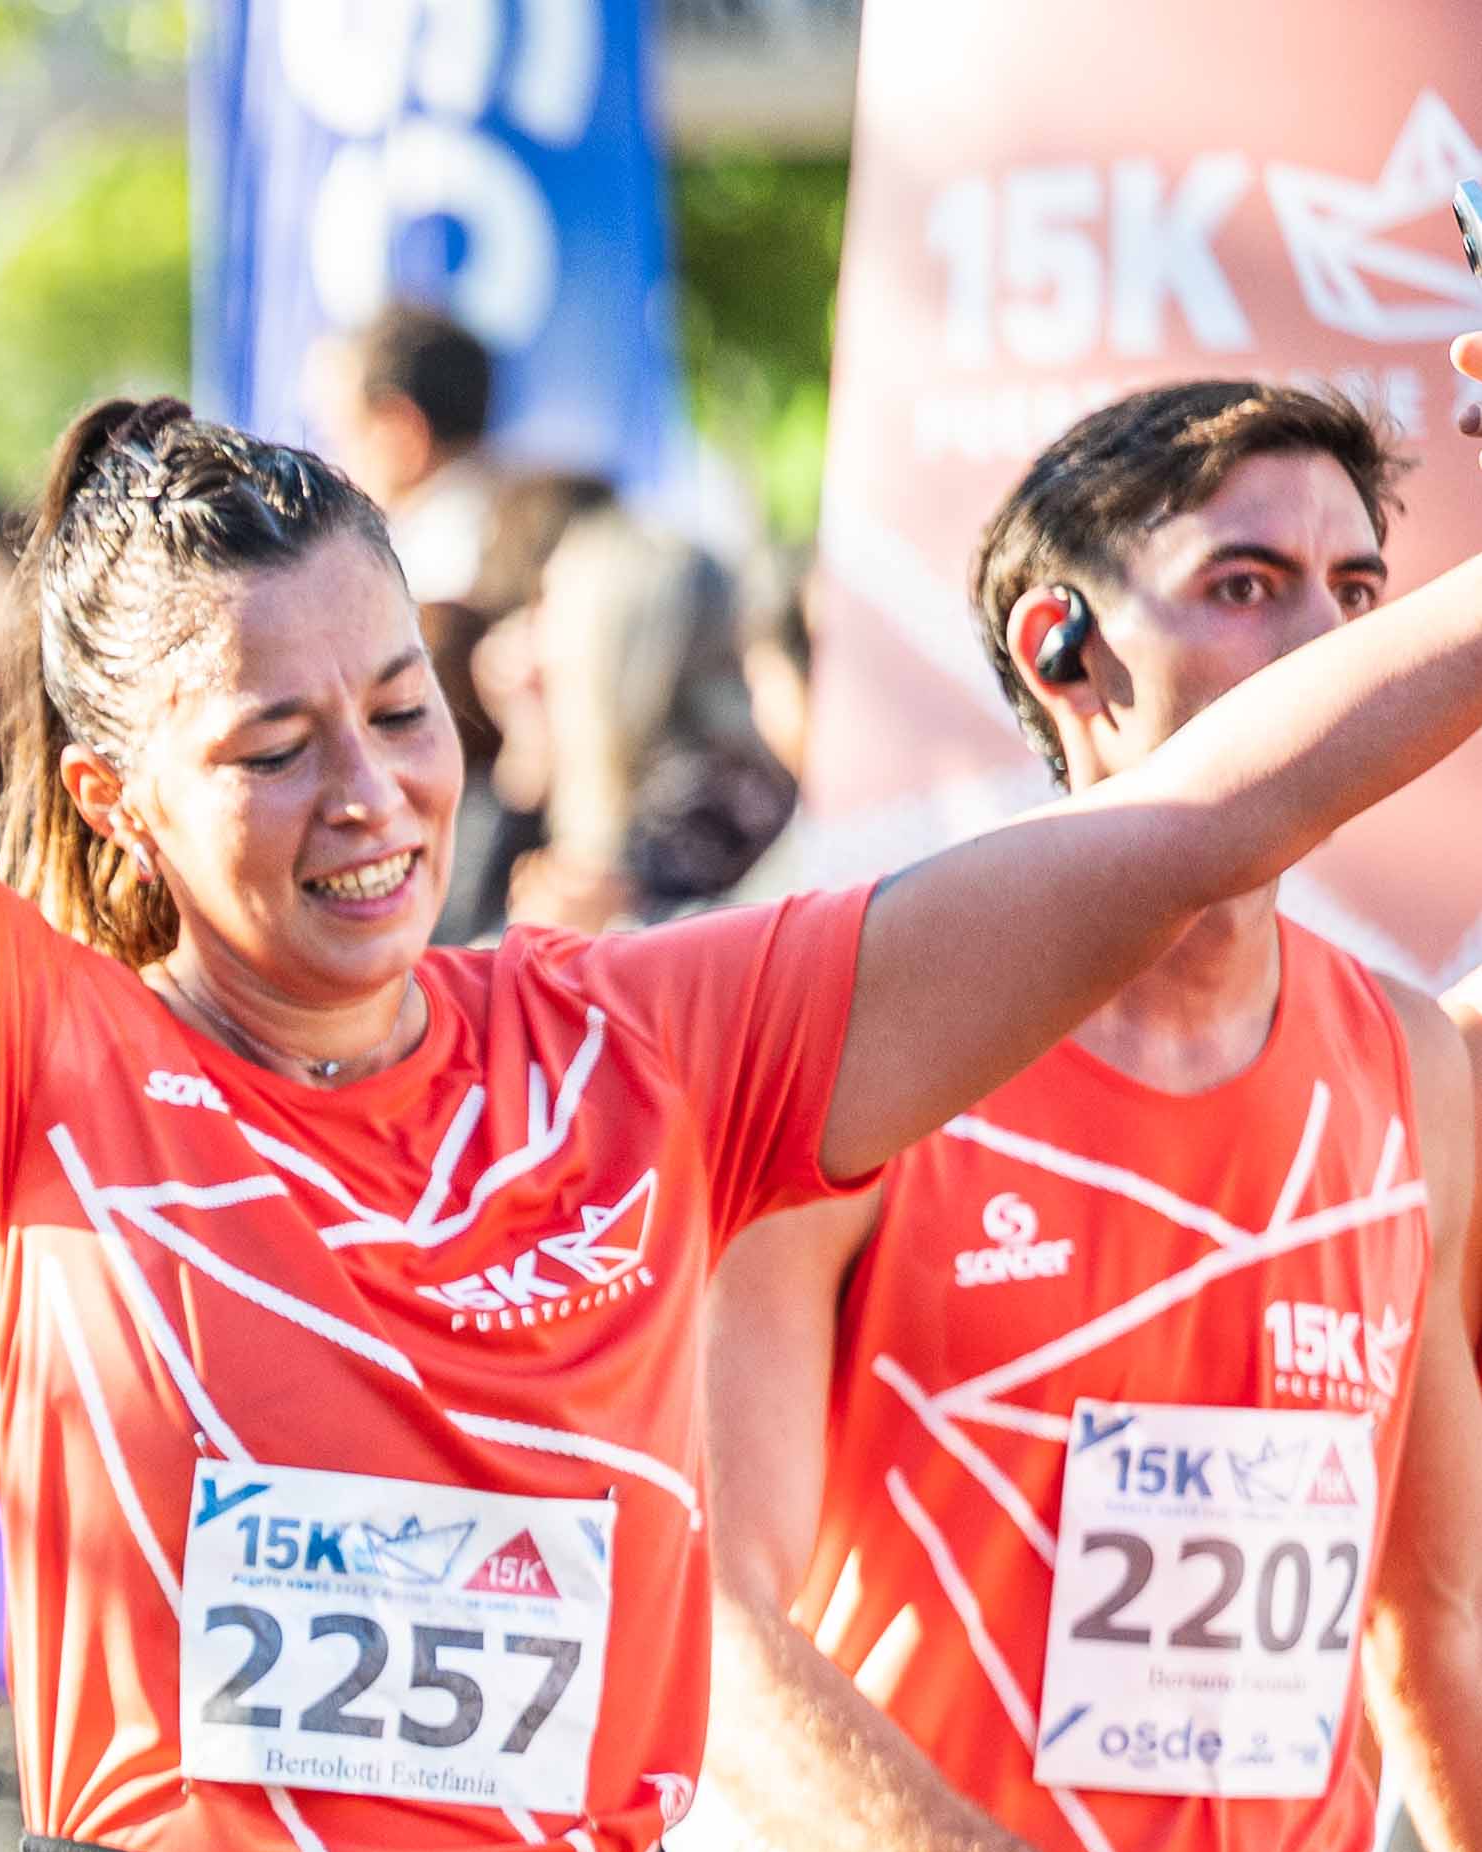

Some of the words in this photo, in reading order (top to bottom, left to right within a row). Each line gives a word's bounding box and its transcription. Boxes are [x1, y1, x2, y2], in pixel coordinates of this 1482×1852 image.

[921, 152, 1257, 370] 15K
[1264, 1300, 1364, 1385] 15K
[1113, 1448, 1213, 1498] 15K
[236, 1513, 348, 1575] 15K
[485, 1554, 544, 1593] 15K
[1070, 1531, 1359, 1653] 2202
[200, 1604, 583, 1755] 2257
[266, 1748, 381, 1785] Bertolotti
[1100, 1715, 1223, 1763] osde
